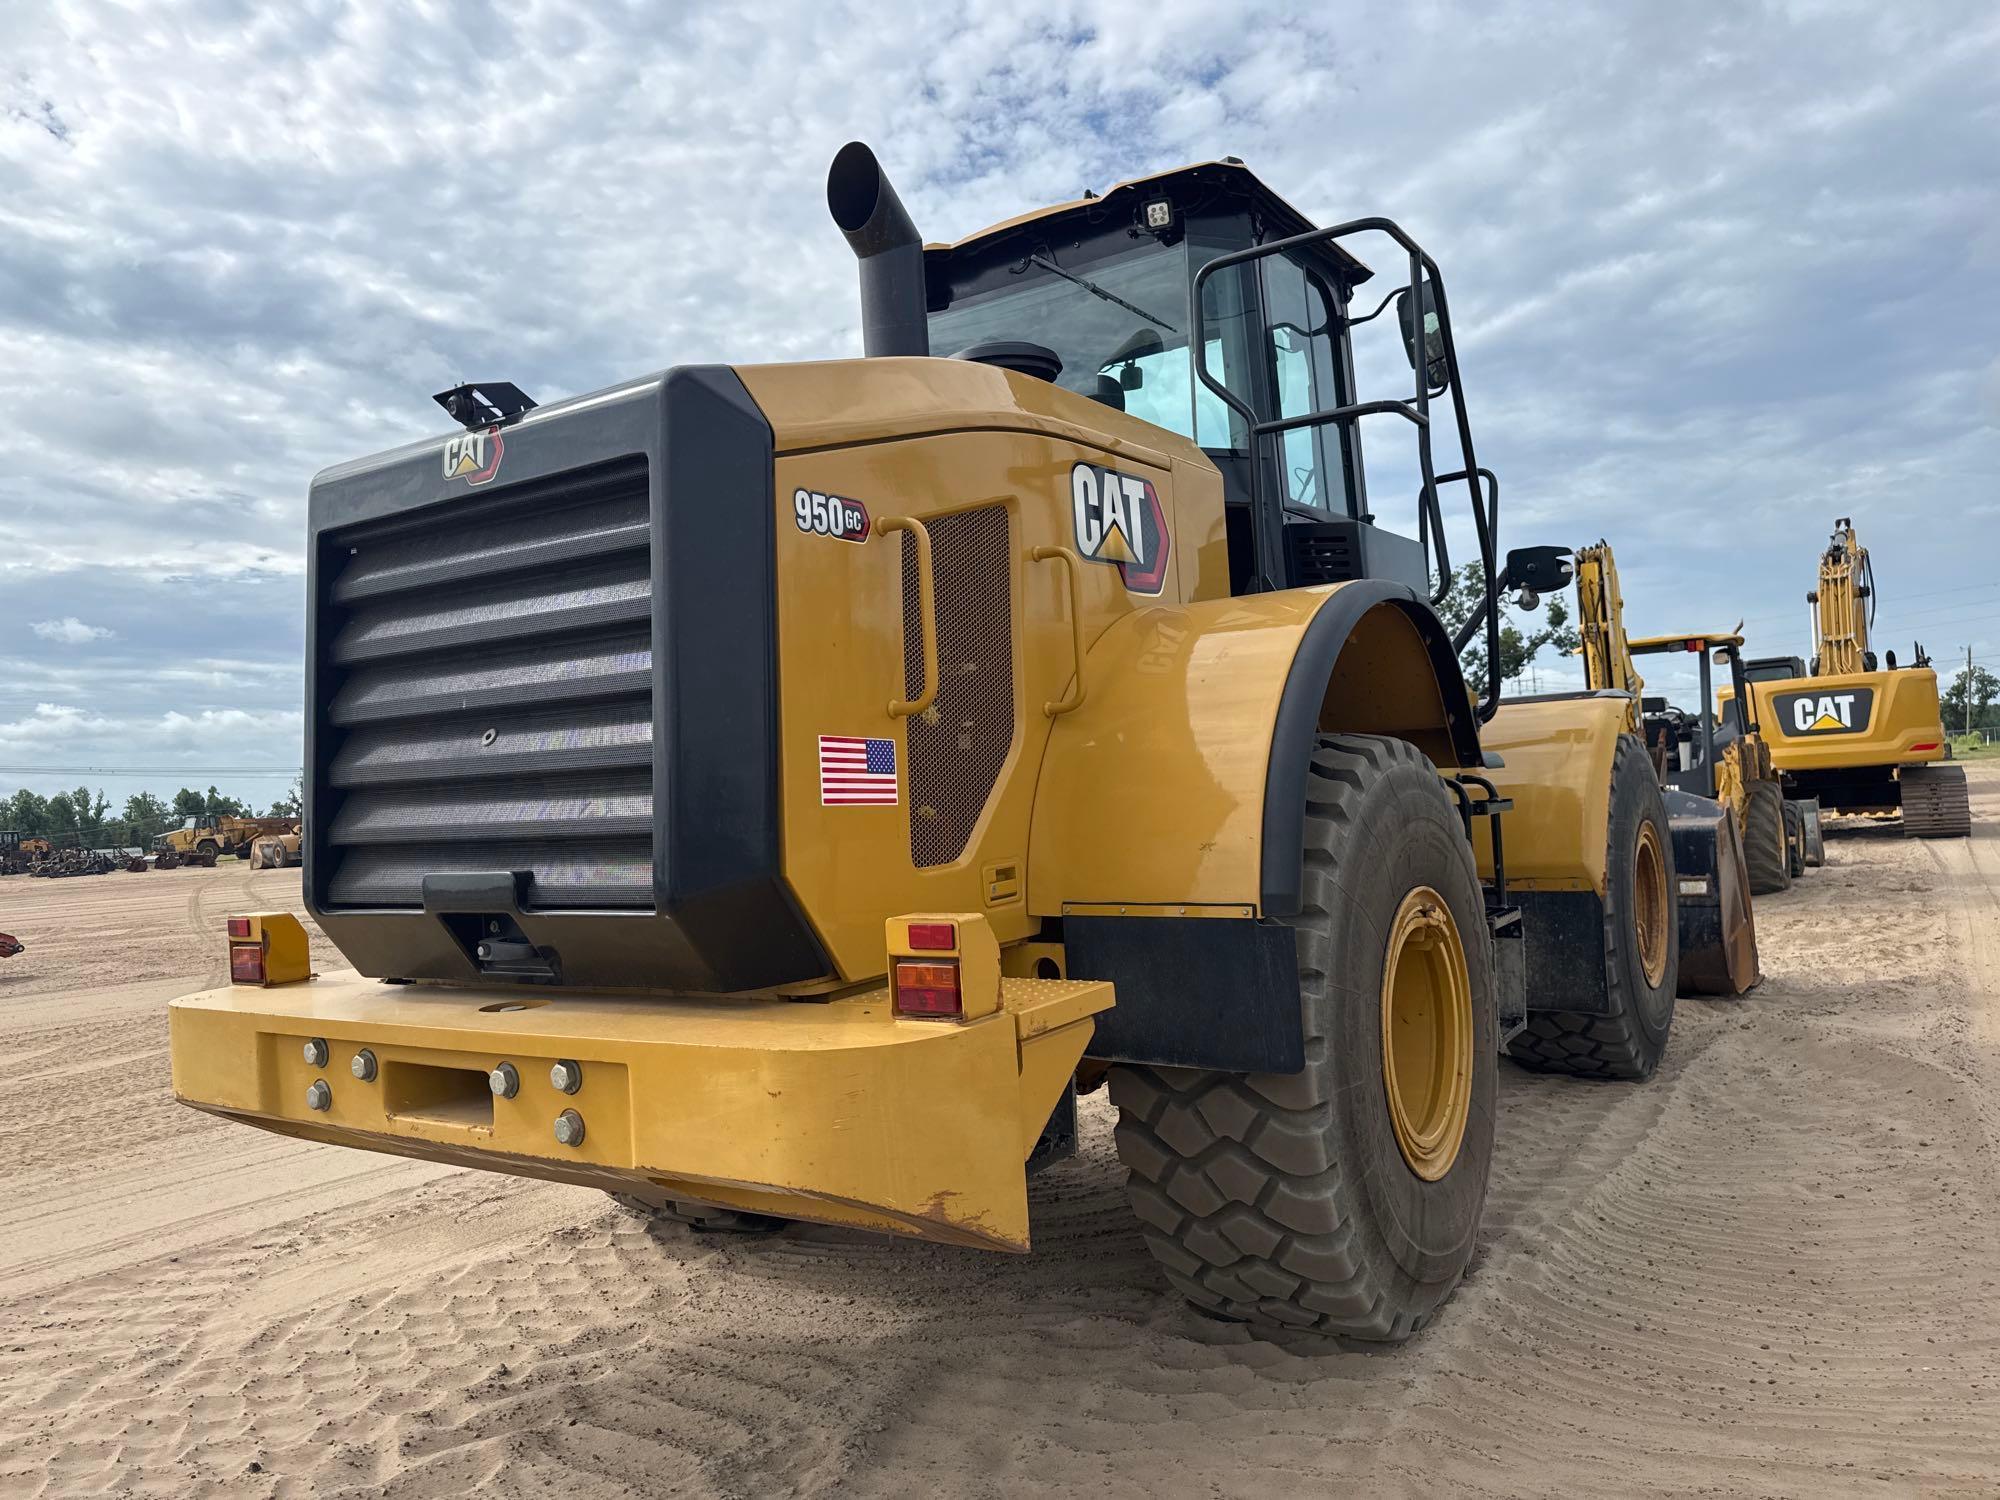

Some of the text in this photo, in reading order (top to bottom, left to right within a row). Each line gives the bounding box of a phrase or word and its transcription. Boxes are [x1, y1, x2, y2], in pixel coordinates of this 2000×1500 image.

[444, 430, 489, 478] CAT
[795, 490, 862, 536] 950 GC
[1072, 464, 1145, 565] CAT
[1793, 694, 1855, 731] CAT
